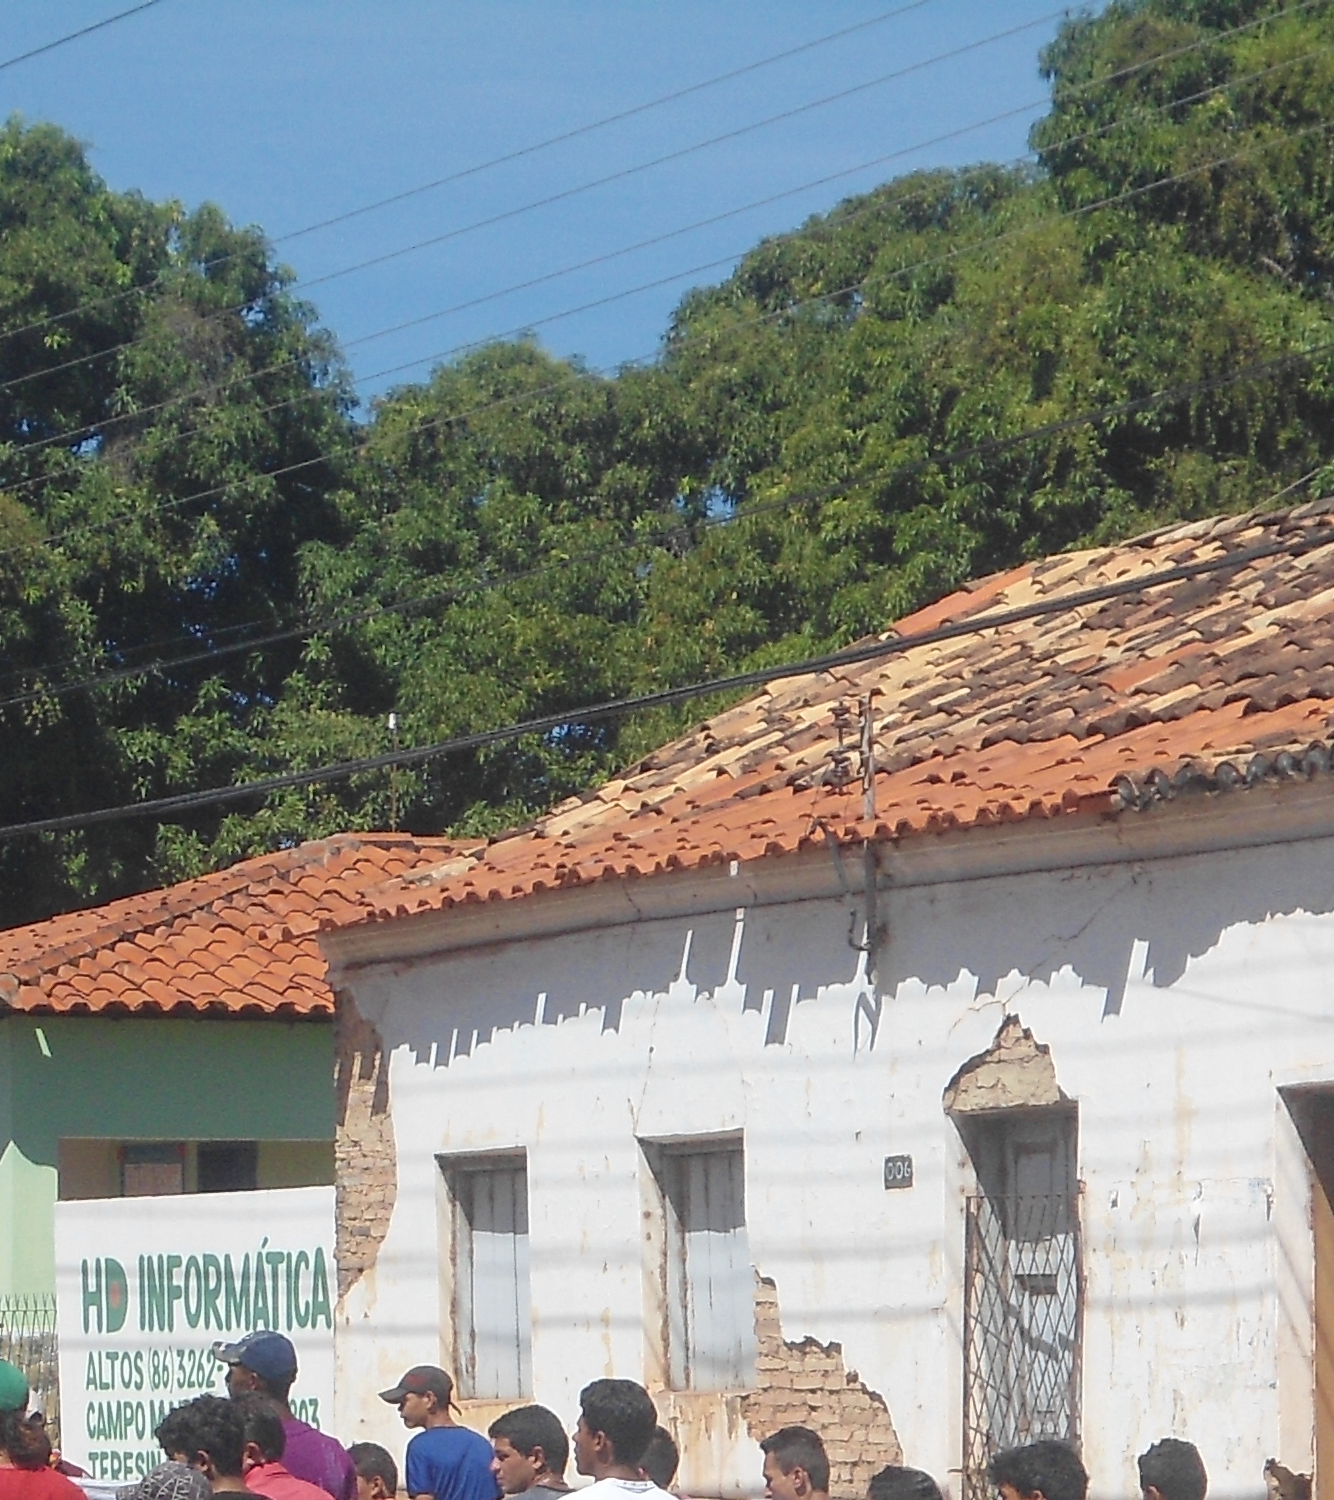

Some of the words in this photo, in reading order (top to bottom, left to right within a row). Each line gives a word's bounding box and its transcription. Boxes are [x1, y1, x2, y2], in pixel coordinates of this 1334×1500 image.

[82, 1257, 128, 1334] HD
[139, 1236, 332, 1332] INFORMÁTICA
[86, 1350, 144, 1391] ALTOS
[176, 1347, 224, 1389] 3262-
[86, 1400, 146, 1441] CAMPO
[88, 1450, 162, 1480] TERESIN
